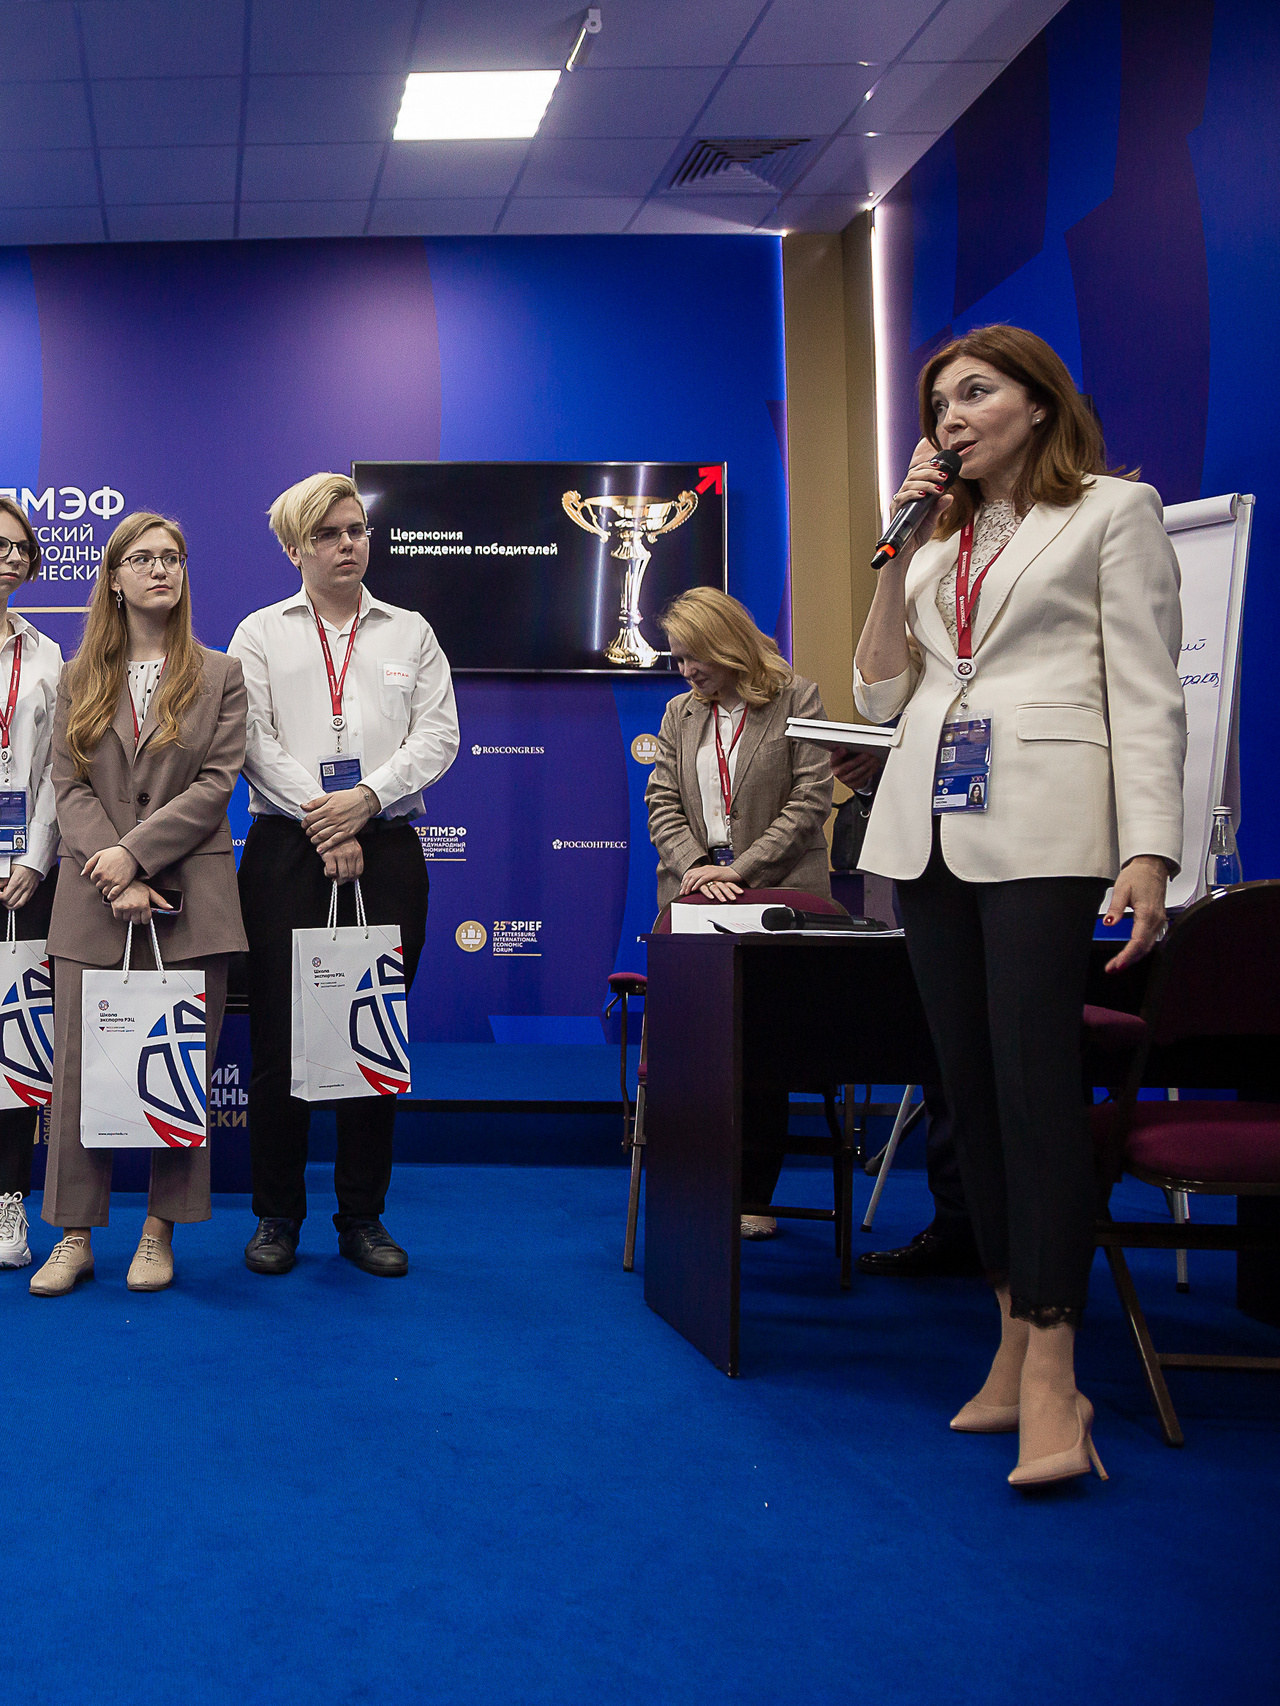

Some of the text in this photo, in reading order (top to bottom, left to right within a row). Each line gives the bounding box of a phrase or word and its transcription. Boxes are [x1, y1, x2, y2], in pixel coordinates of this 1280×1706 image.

[390, 528, 463, 543] Церемония
[390, 543, 558, 557] награждение победителей
[482, 746, 545, 755] ROSCONGRESS
[430, 826, 467, 837] ПМЭФ
[563, 840, 627, 849] РОСКОНГРЕСС
[511, 921, 542, 931] SPIEF
